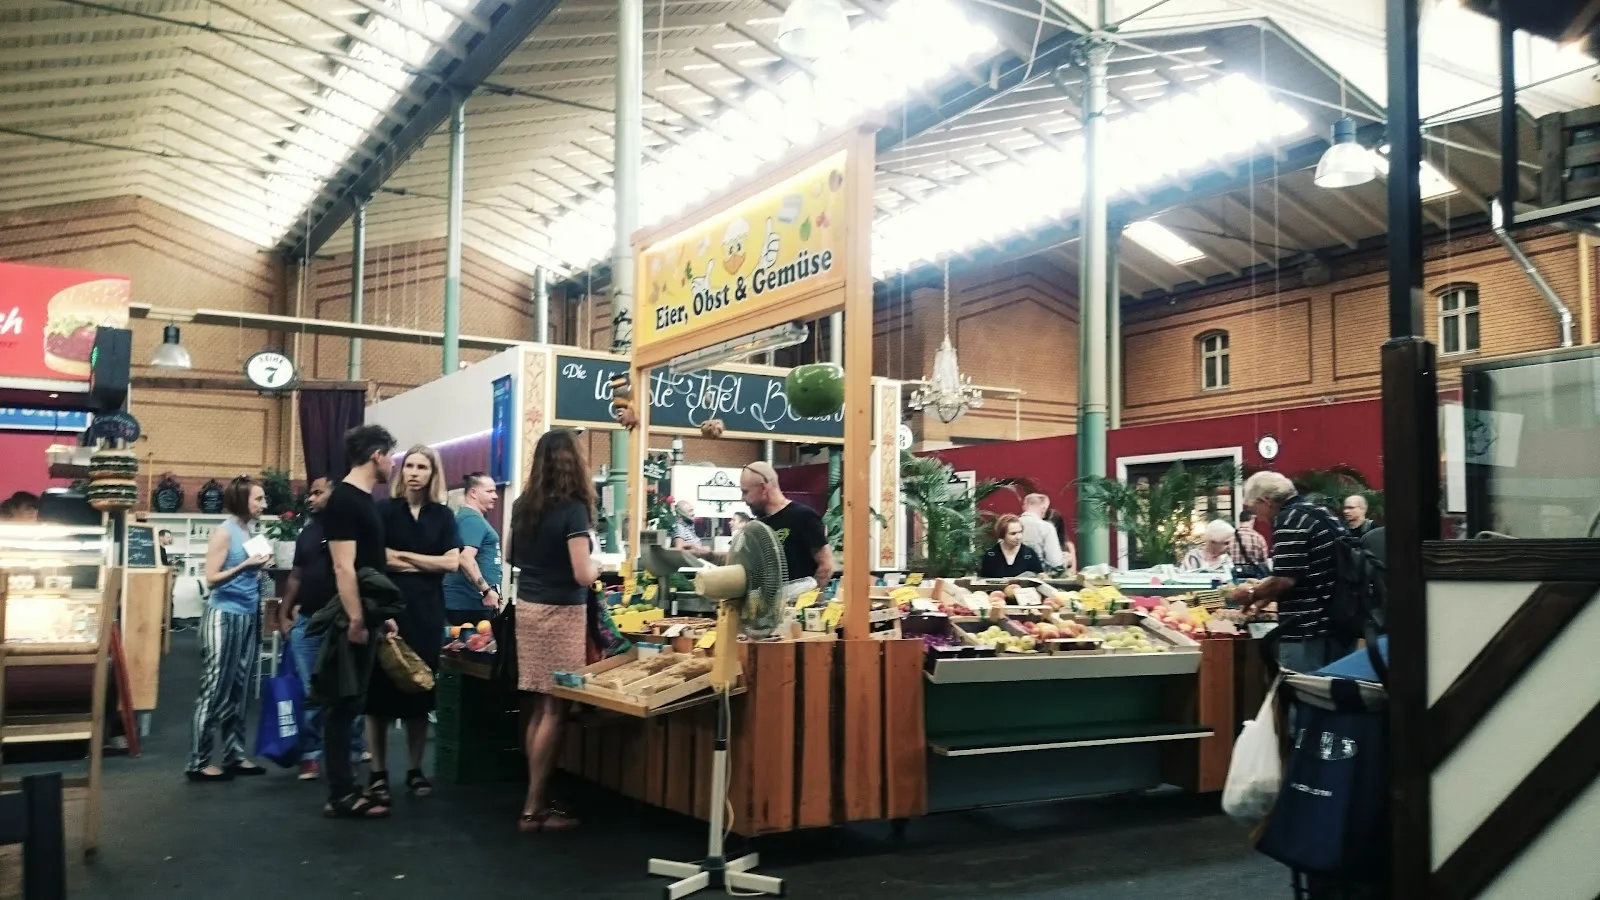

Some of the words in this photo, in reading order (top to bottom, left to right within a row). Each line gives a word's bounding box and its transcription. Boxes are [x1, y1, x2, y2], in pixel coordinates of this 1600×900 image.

[655, 303, 689, 331] Eier,
[692, 284, 730, 318] Obst
[734, 276, 747, 301] &
[752, 248, 833, 295] Gemüse
[264, 366, 278, 384] 7
[562, 362, 588, 379] Die
[682, 374, 746, 427] Tafel
